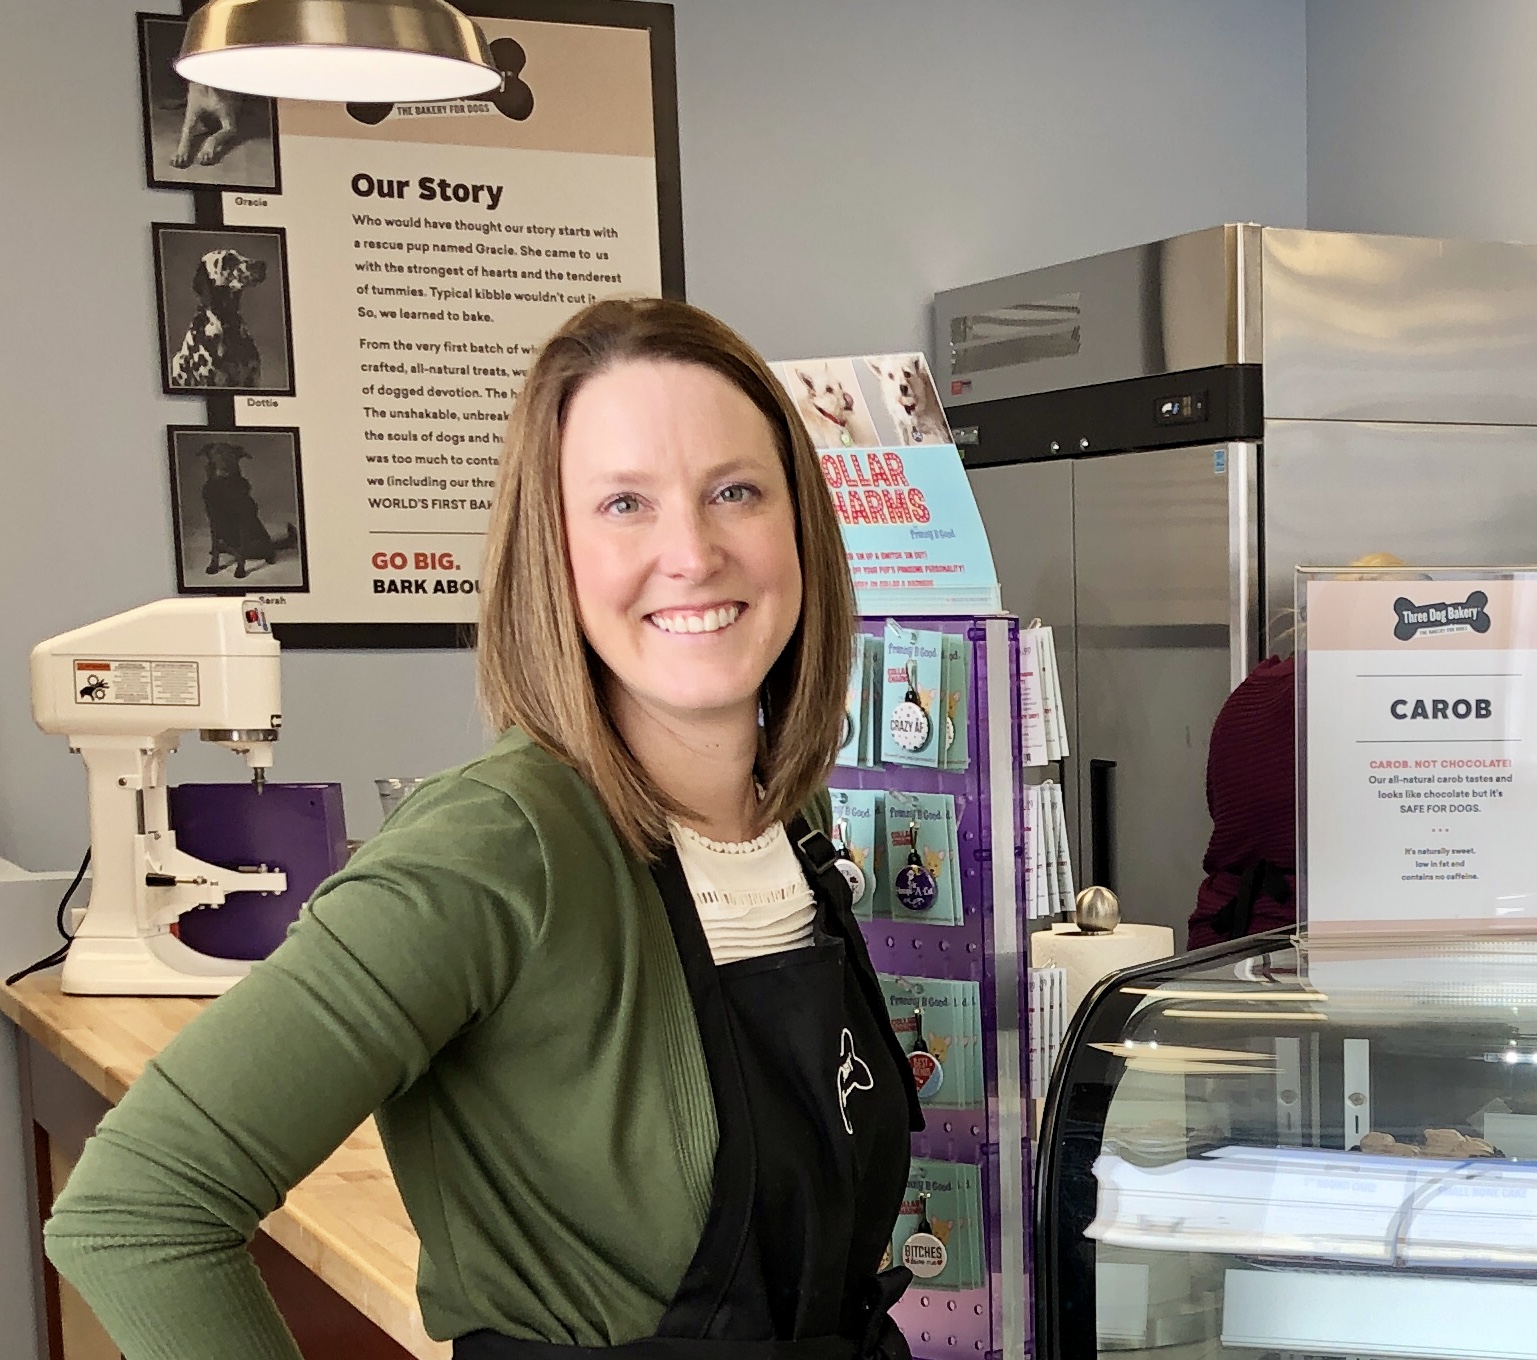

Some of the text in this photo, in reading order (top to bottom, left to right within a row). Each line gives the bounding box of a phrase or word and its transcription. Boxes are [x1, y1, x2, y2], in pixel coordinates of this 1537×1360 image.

[397, 103, 490, 116] THE BAKERY FOR DOGS
[351, 173, 503, 210] Our Story
[234, 197, 268, 208] Gracie
[352, 213, 619, 239] Who would have thought our story starts with
[354, 240, 609, 261] a rescue pup named Gracie. She came to us
[355, 261, 622, 284] with the strongest of hearts and the tenderest
[356, 284, 586, 304] of tummies. Typical kibble wouldn't cut
[379, 309, 397, 319] we
[399, 307, 445, 321] learned
[447, 310, 460, 321] to
[462, 310, 494, 323] bake.
[360, 339, 390, 350] From
[393, 340, 413, 350] the
[415, 342, 441, 355] very
[444, 341, 468, 353] first
[470, 342, 503, 354] batch
[506, 343, 519, 355] of
[411, 363, 470, 376] all-natural
[362, 385, 375, 395] of
[377, 385, 424, 399] dogged
[427, 387, 482, 398] devotion.
[485, 388, 508, 399] The
[247, 397, 279, 408] Dottie
[363, 407, 387, 418] The
[364, 430, 384, 441] the
[387, 430, 418, 442] souls
[420, 431, 433, 442] of
[435, 431, 466, 445] dogs
[468, 433, 490, 444] and
[366, 453, 464, 466] was too much to
[820, 451, 910, 489] OLLAR
[367, 476, 470, 490] we (including our
[367, 497, 466, 510] WORLD'S FIRST
[834, 488, 931, 525] HARMS
[371, 552, 461, 571] GO BIG.
[373, 579, 428, 594] BARK
[1402, 605, 1479, 624] Three Dog Bakery
[1390, 698, 1492, 720] CAROB
[890, 720, 912, 733] CRAZY
[1369, 760, 1412, 769] CAROB.
[1415, 760, 1438, 769] NOT
[1368, 774, 1513, 784] Our all-natural carob tastes and
[1378, 789, 1503, 799] looks like chocolate but it's
[1400, 804, 1481, 814] SAFE FOR DOGS.
[1417, 847, 1450, 858] naturally
[1401, 873, 1434, 881] contains
[905, 1244, 942, 1259] BITCHES
